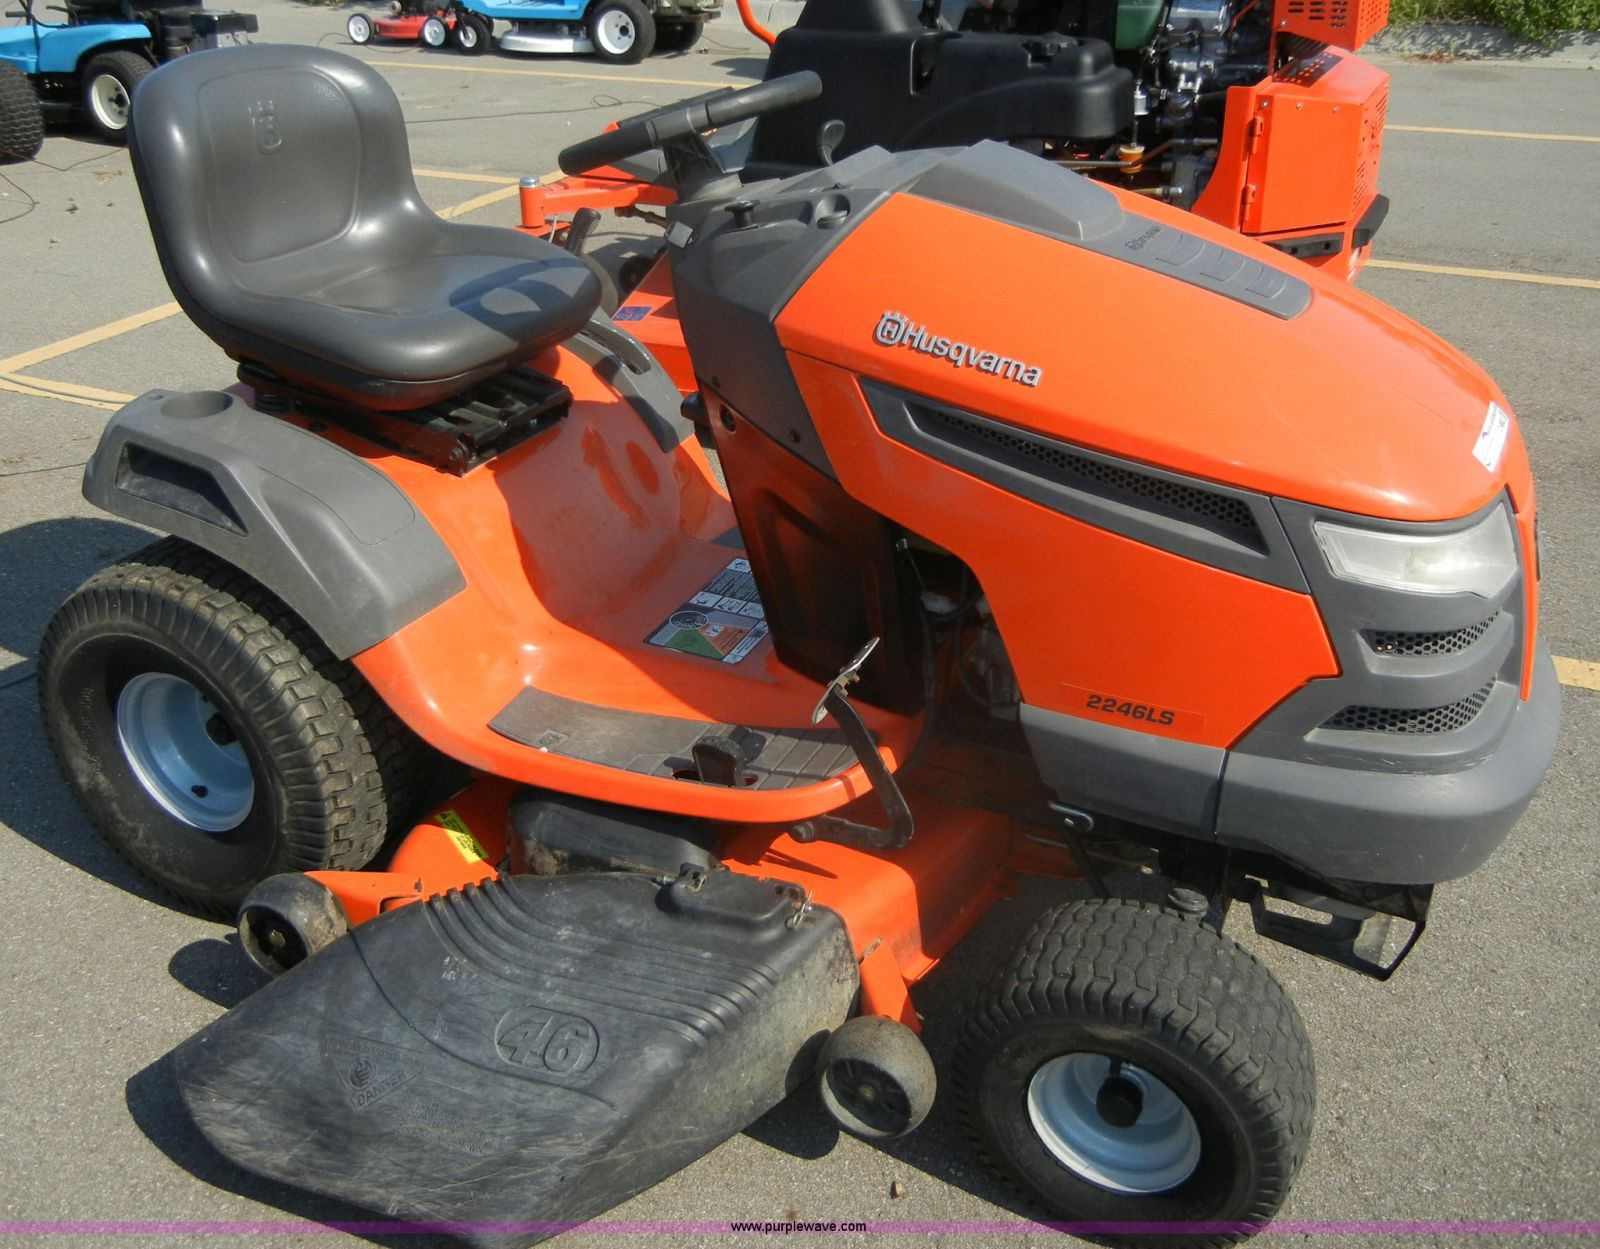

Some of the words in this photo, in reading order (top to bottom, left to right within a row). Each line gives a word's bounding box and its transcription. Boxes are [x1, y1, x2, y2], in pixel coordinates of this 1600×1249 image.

[901, 321, 1042, 387] Husqvarna
[1086, 694, 1176, 726] 2246LS
[497, 1014, 591, 1073] 46
